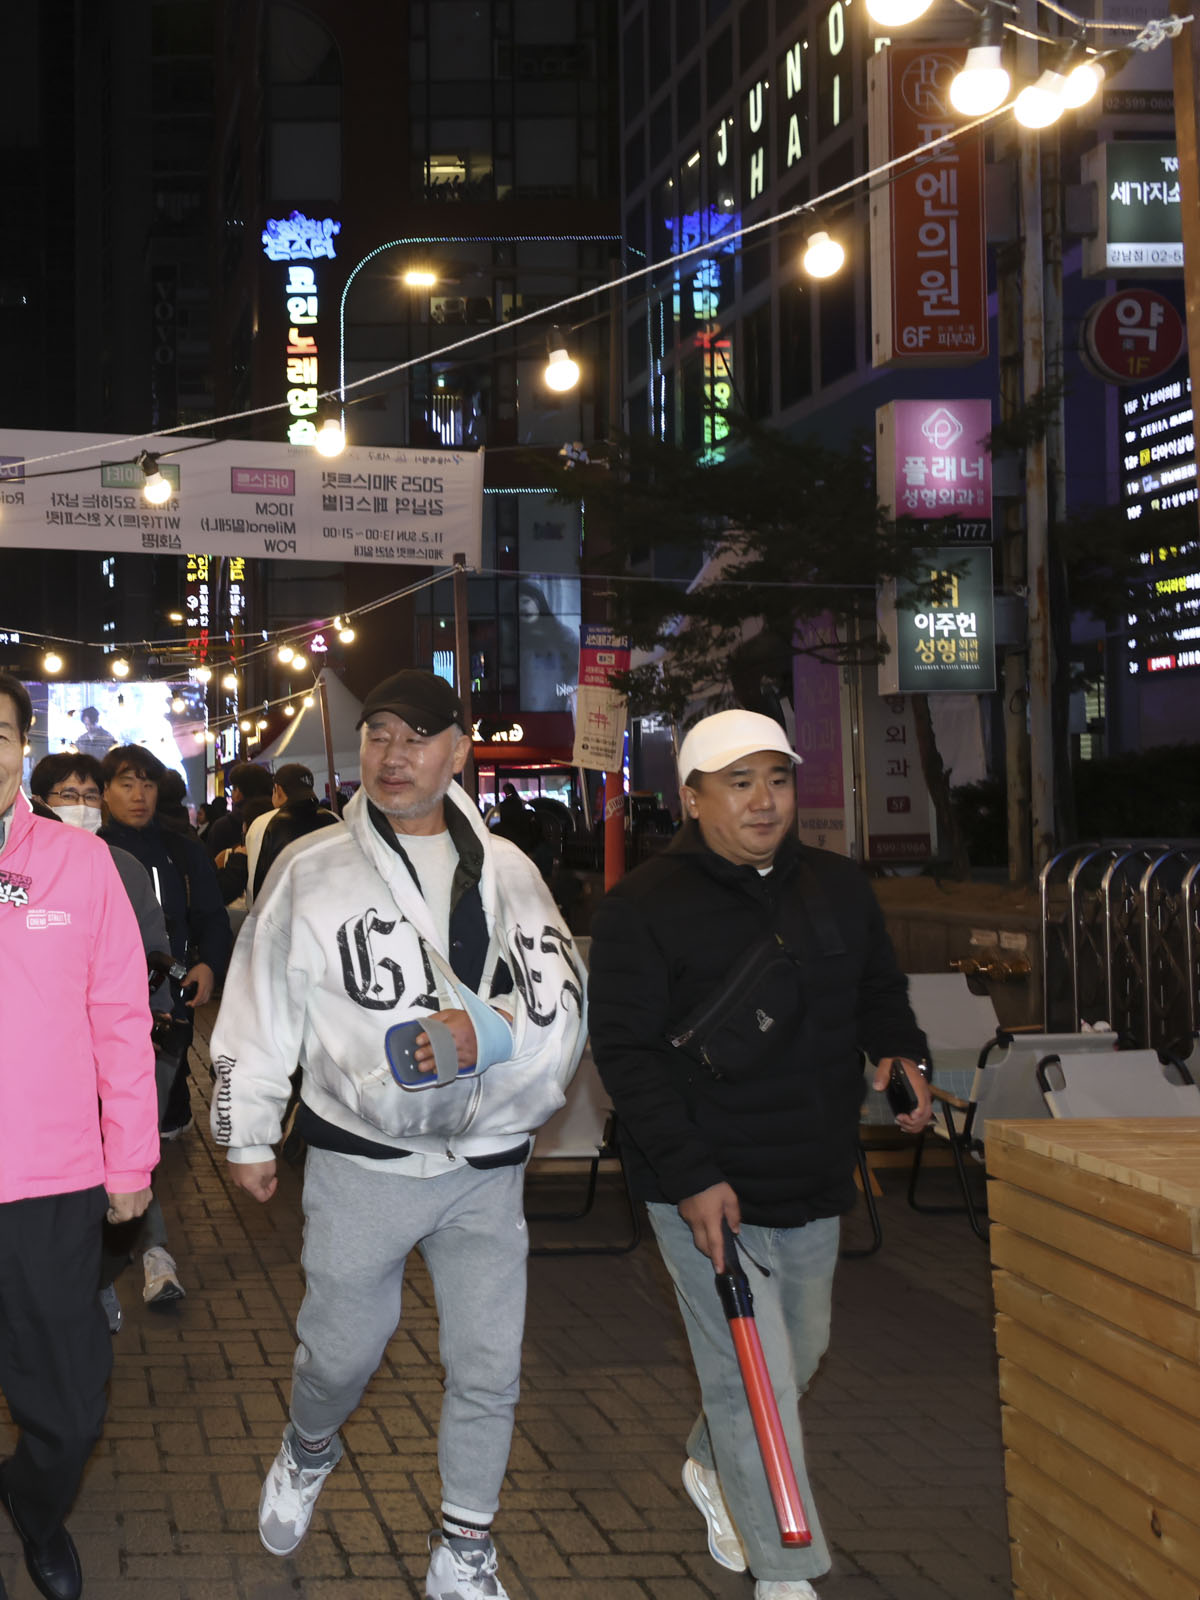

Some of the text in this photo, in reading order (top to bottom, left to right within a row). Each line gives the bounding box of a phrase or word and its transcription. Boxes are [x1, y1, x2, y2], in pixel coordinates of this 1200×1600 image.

[717, 0, 844, 167] JUNO
[902, 326, 931, 349] 6F
[1115, 298, 1165, 351] 약
[902, 455, 985, 486] 플래너
[902, 488, 974, 509] 성형외과
[914, 612, 978, 638] 이주헌
[914, 638, 958, 664] 성형
